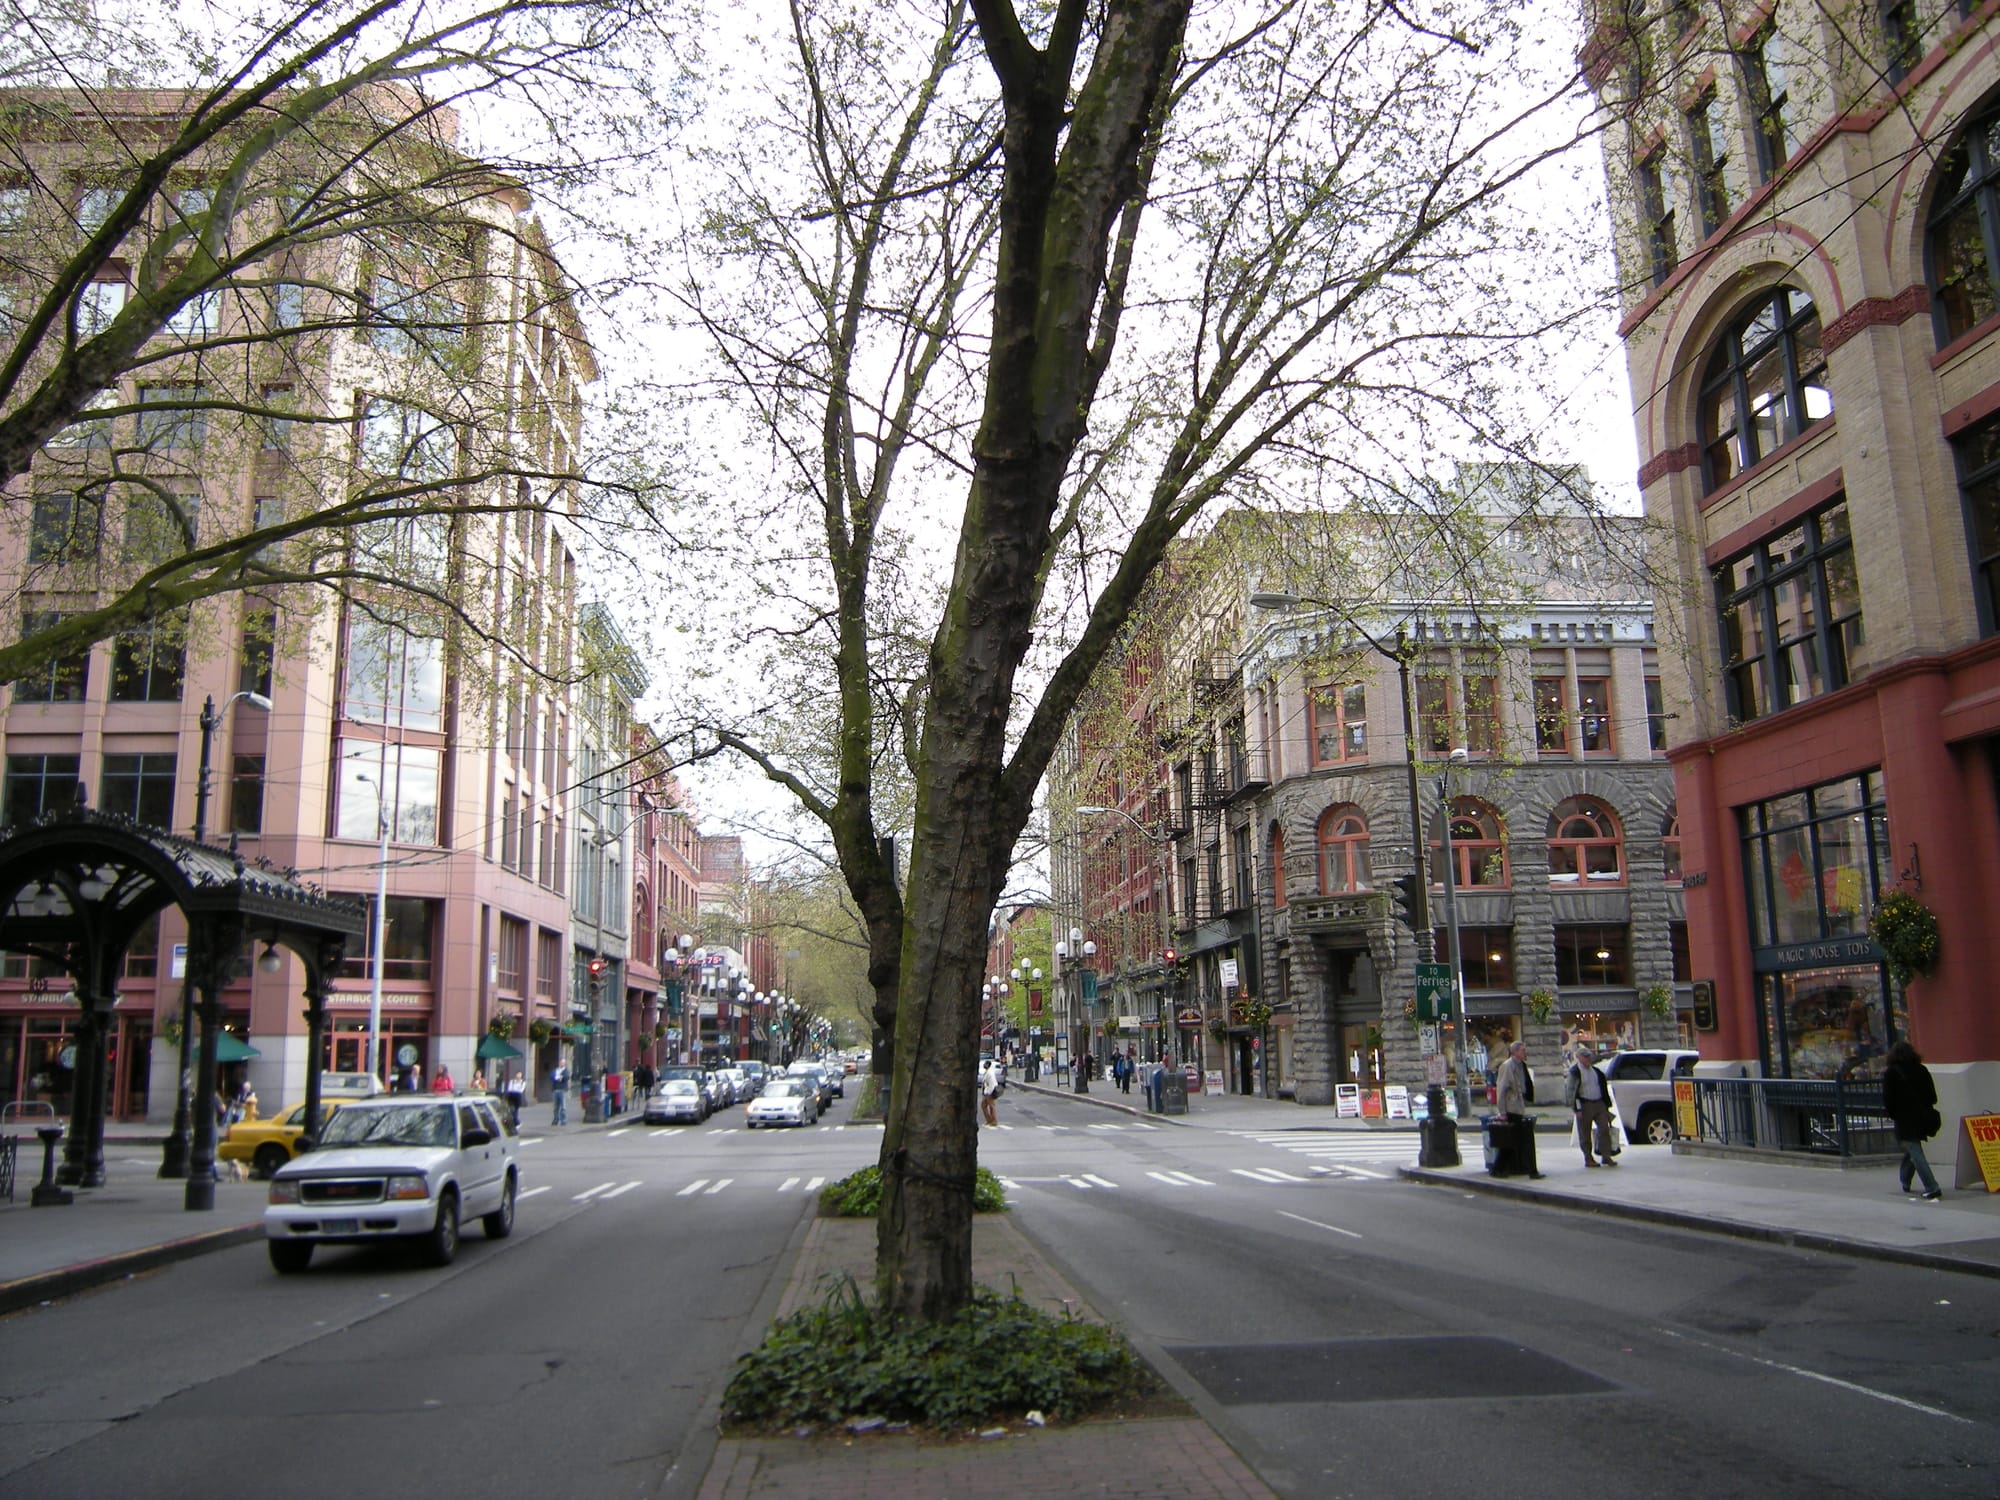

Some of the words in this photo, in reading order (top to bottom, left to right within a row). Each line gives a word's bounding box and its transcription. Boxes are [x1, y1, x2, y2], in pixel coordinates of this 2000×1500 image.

[1778, 948, 1804, 964] MAGIC
[1810, 945, 1840, 960] MOUSE
[1847, 943, 1870, 956] TOYS
[1429, 967, 1438, 975] TO
[1417, 975, 1450, 986] Ferries
[327, 993, 382, 1004] STARBUC
